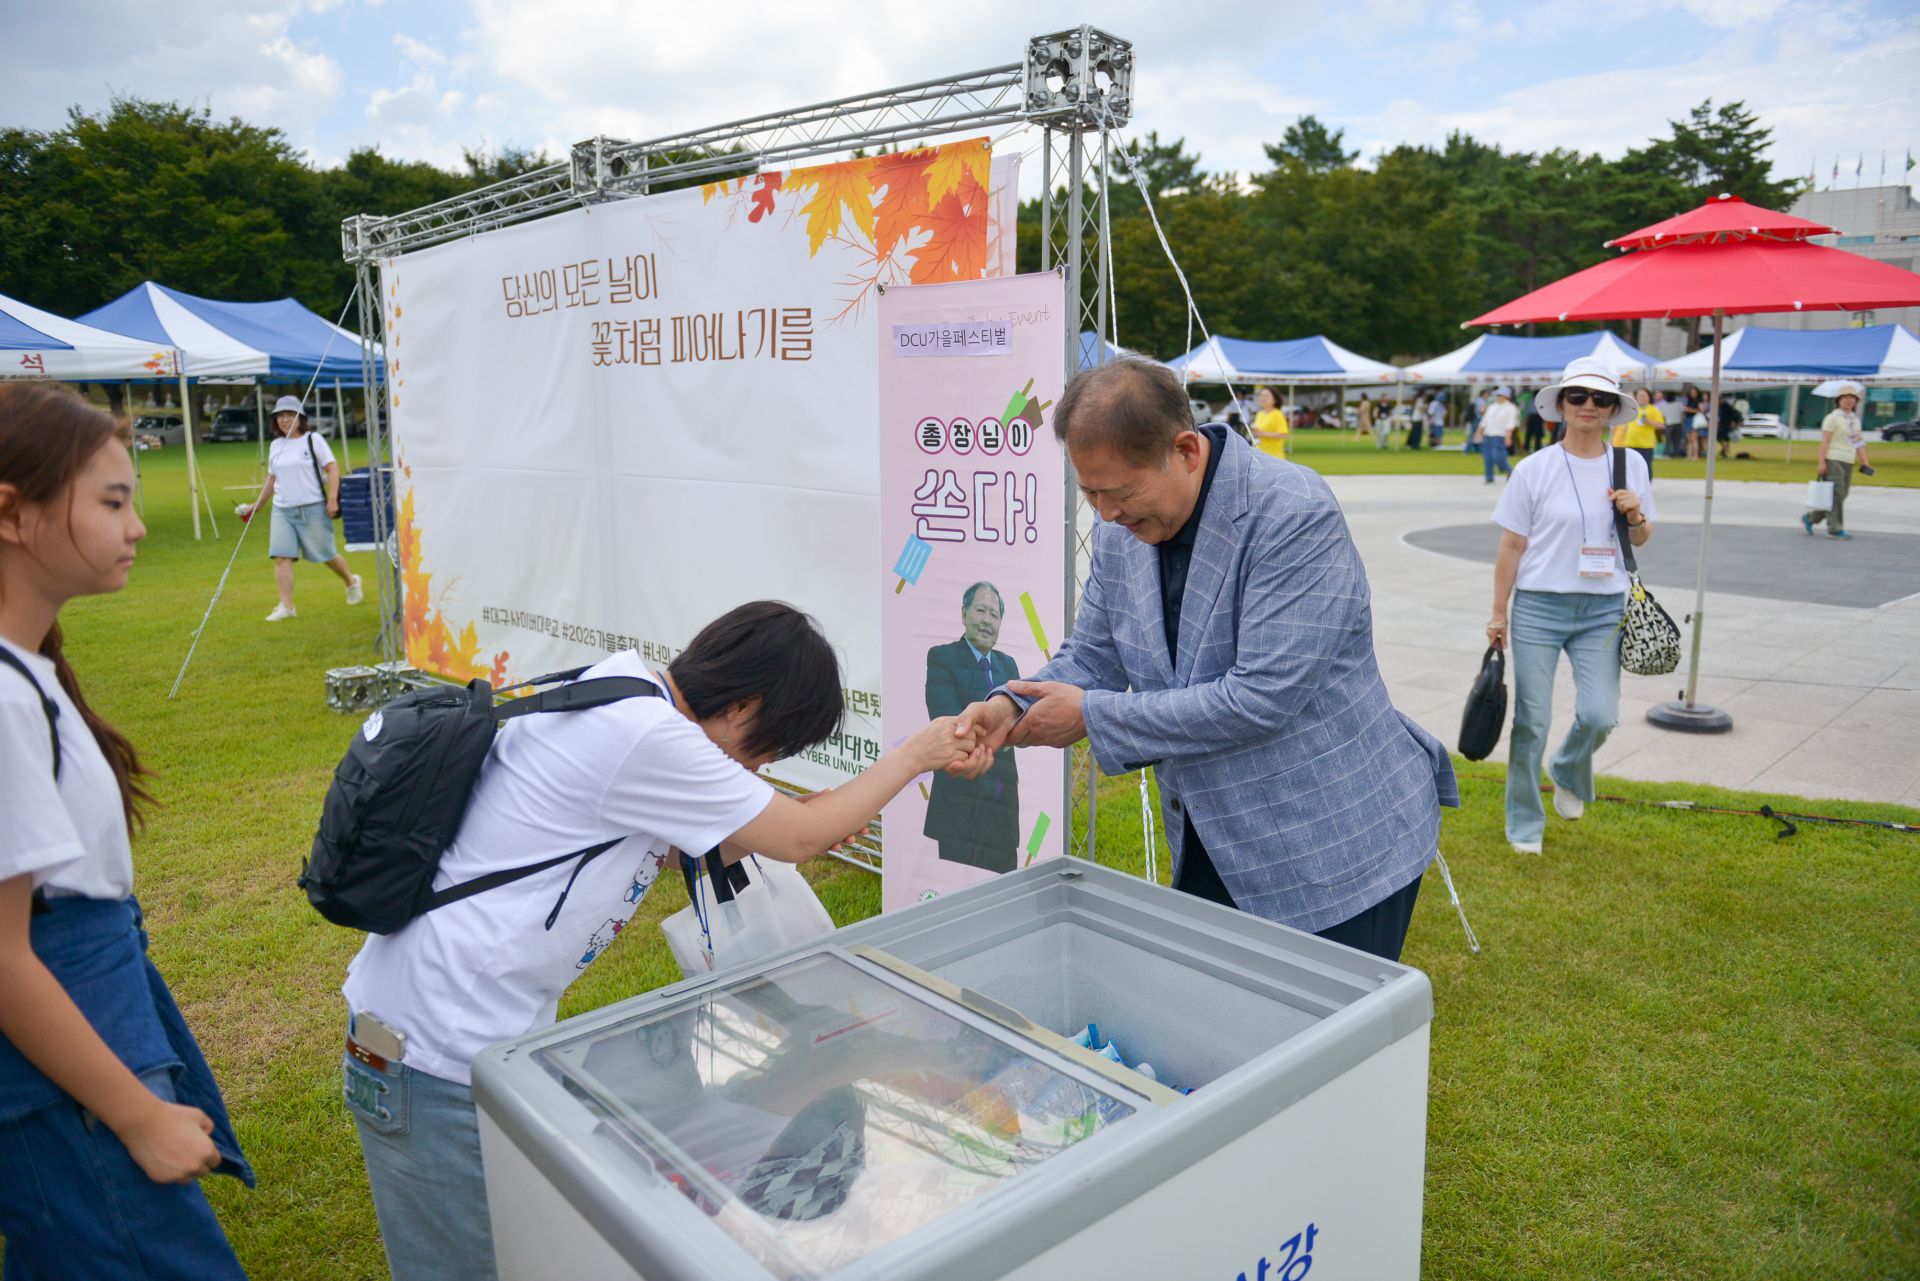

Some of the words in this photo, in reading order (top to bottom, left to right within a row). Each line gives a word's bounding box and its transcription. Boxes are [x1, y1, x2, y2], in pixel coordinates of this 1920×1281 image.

[502, 269, 558, 318] 당신의
[563, 259, 600, 308] 모든
[609, 253, 658, 304] 날이
[591, 318, 661, 367] 꽃처럼
[670, 307, 814, 362] 피어나기를
[900, 327, 1007, 349] DCU가을페스티벌
[1008, 304, 1052, 329] Event
[19, 353, 46, 374] 석
[921, 423, 1028, 450] 총장님이
[911, 469, 1038, 546] 쏜다!
[482, 606, 560, 638] #대구사이버대학교
[562, 625, 640, 653] #2025가을축제
[643, 641, 672, 666] #너의
